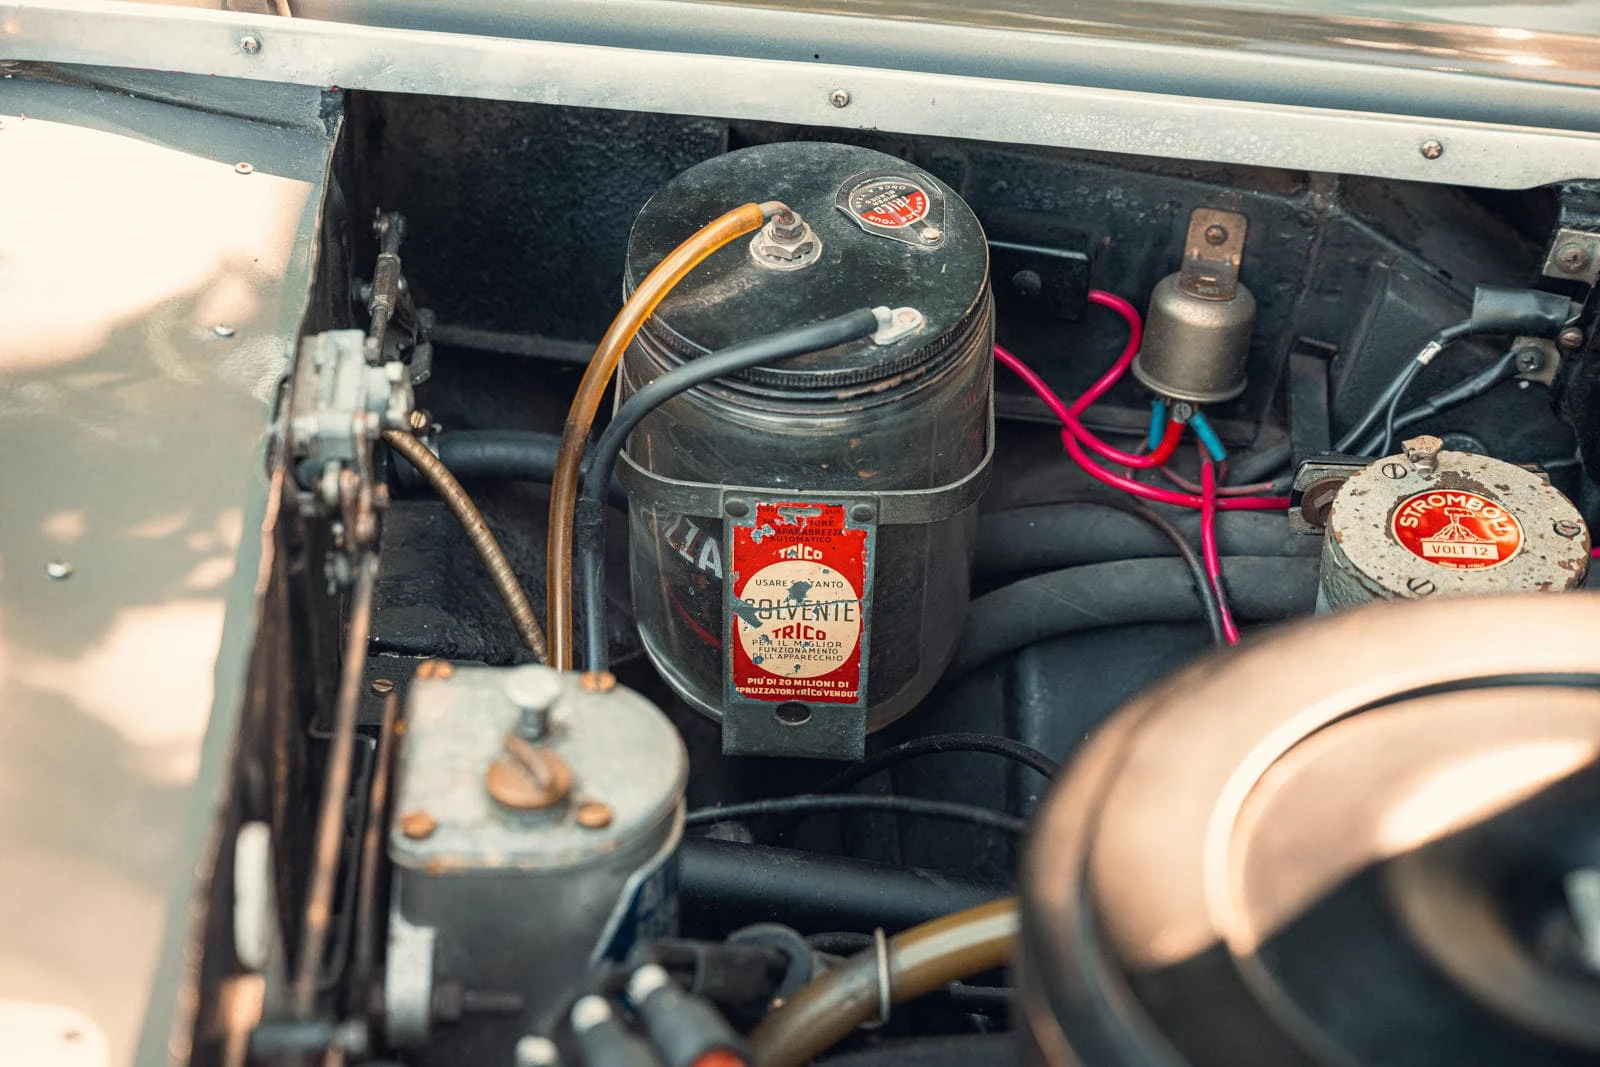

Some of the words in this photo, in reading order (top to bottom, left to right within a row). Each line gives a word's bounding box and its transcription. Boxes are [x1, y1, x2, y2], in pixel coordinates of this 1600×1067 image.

[1399, 494, 1514, 531] STROMBOLI
[778, 543, 823, 560] TRICO
[1431, 545, 1465, 555] VOLT
[1473, 547, 1489, 556] 12
[755, 579, 787, 587] USARE
[791, 579, 844, 589] STANTO
[772, 622, 827, 641] TRICO
[794, 640, 842, 649] MGLIOR
[758, 646, 839, 655] FUNZIONAMENTO
[778, 678, 792, 687] 20
[793, 679, 835, 688] MILIONI
[838, 680, 849, 688] DI
